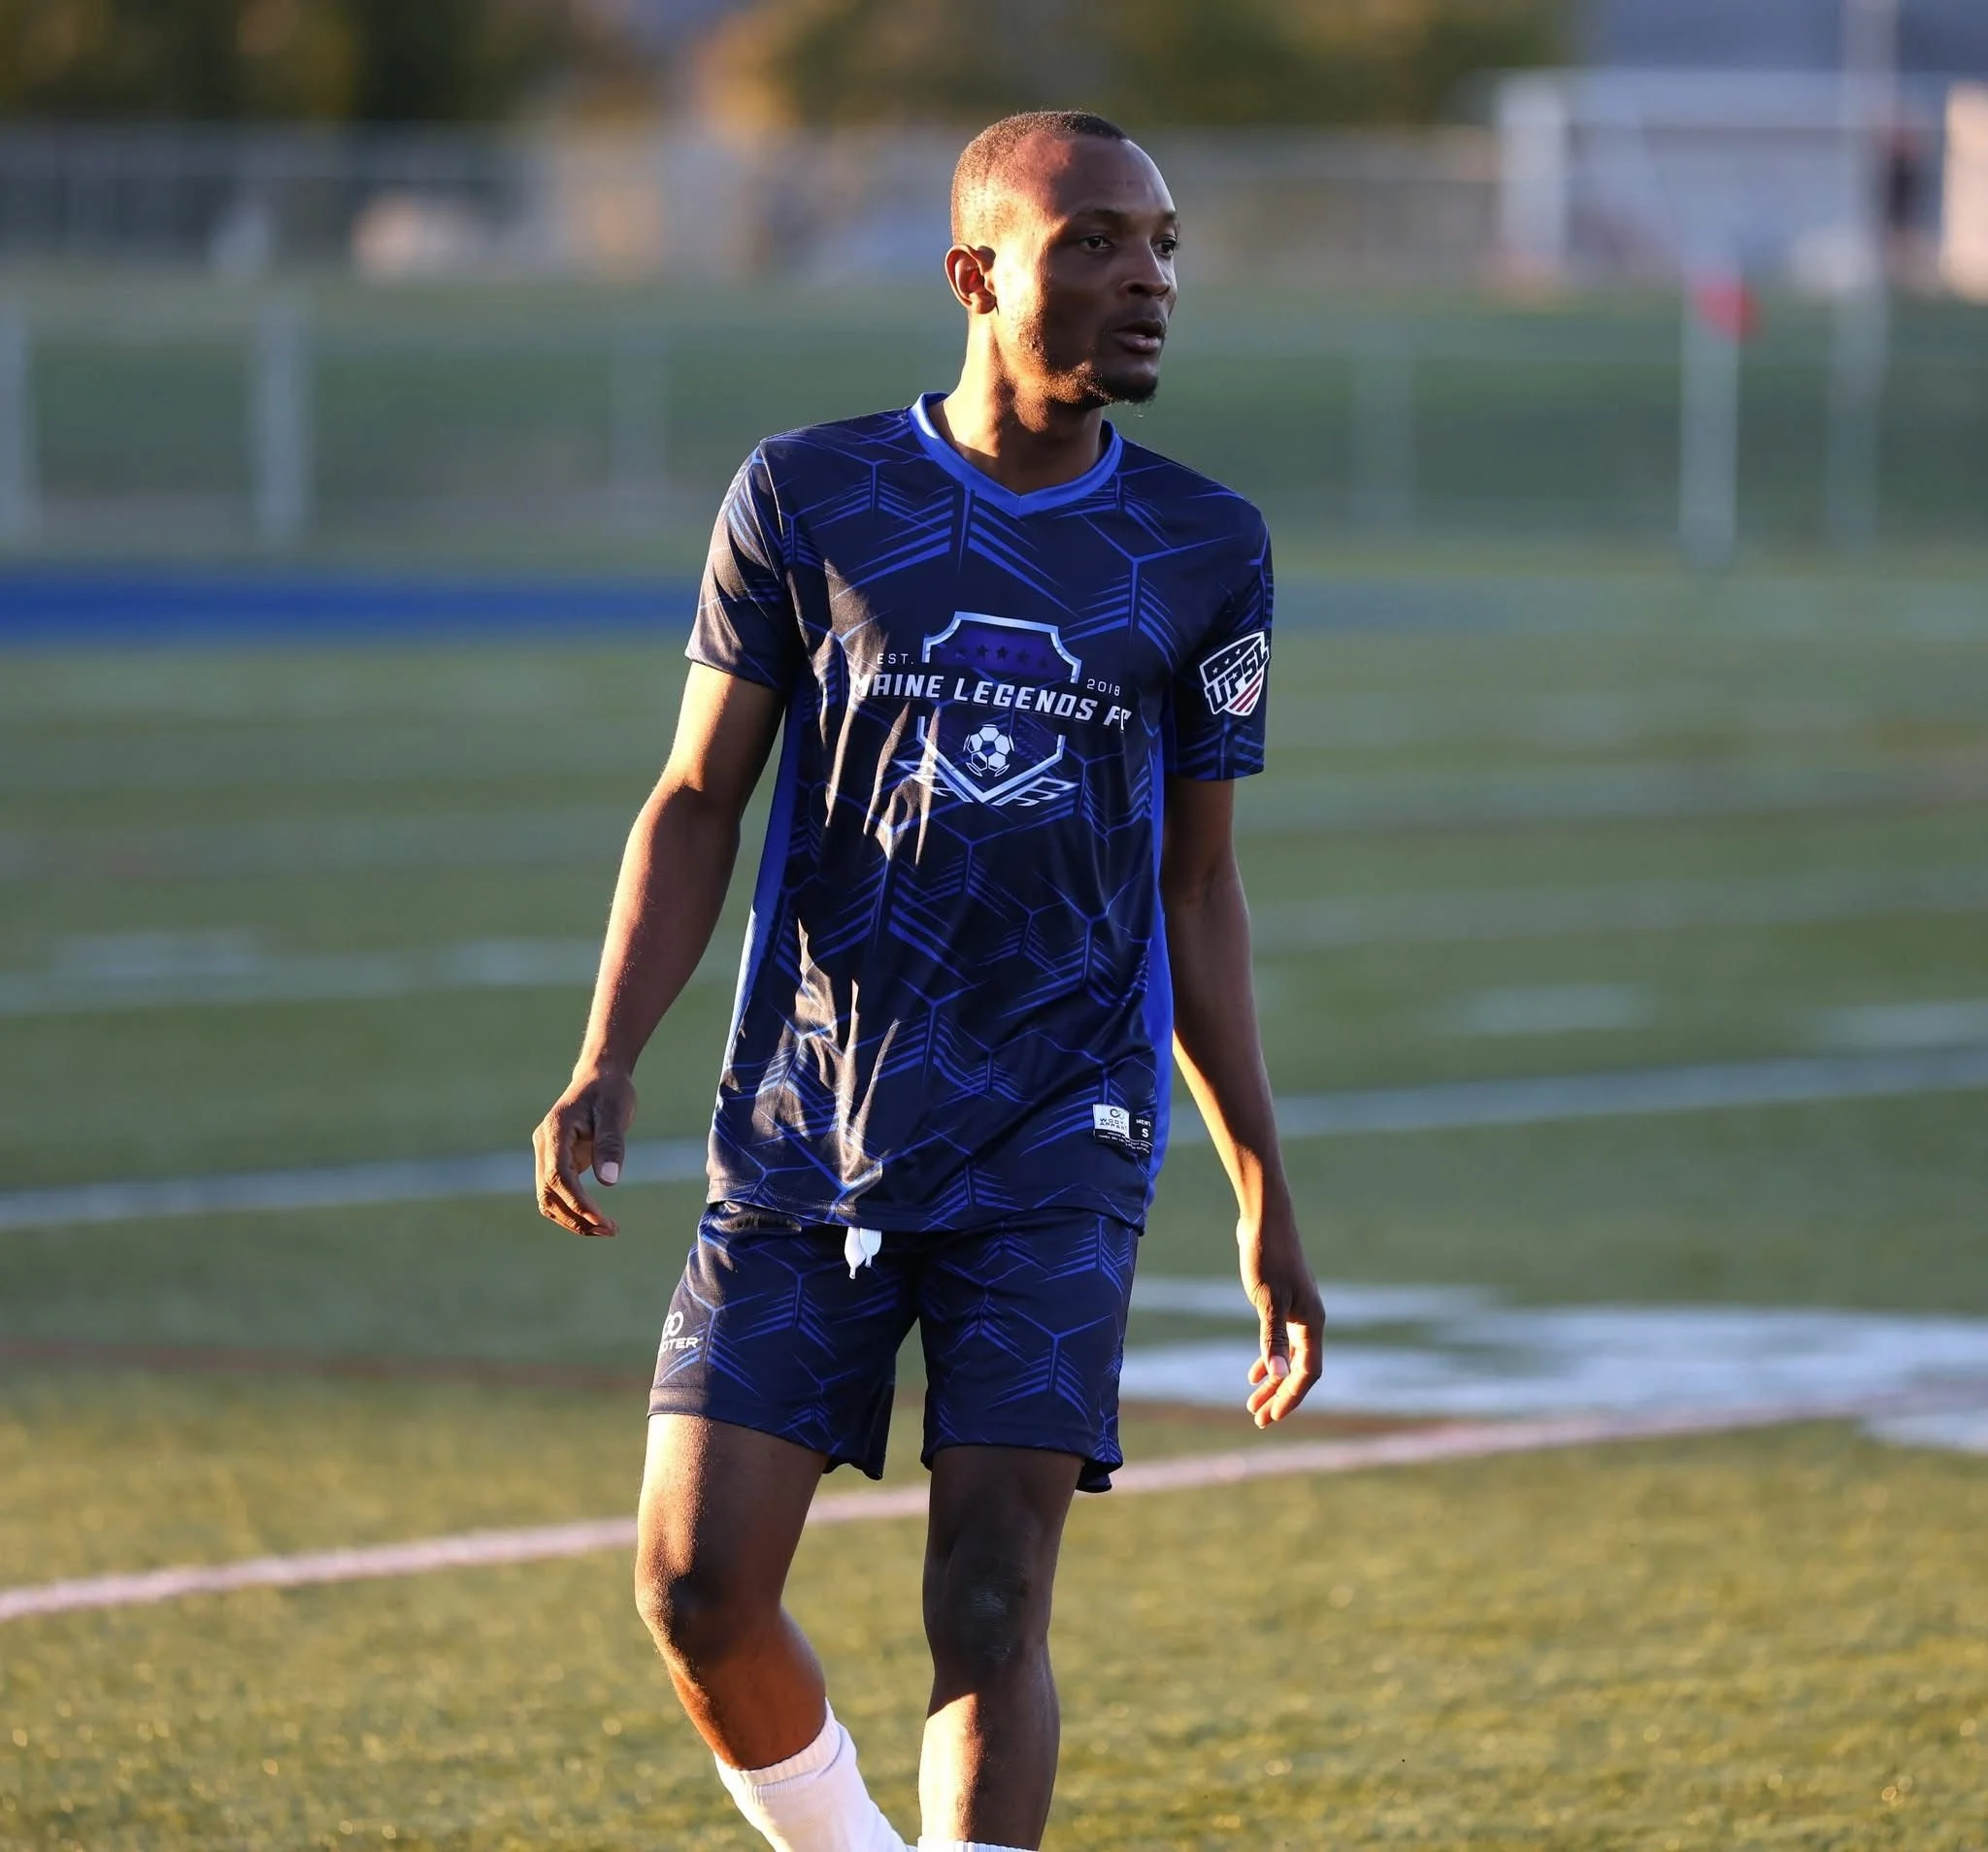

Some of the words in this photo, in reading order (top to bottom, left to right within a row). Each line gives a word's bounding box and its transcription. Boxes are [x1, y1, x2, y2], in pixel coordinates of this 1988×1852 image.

[877, 653, 913, 664] EST.
[1204, 640, 1270, 714] UPSL
[1087, 678, 1120, 696] 2018
[954, 678, 1098, 721] LEGENDS
[1142, 1128, 1148, 1138] S
[659, 1337, 699, 1352] OTER
